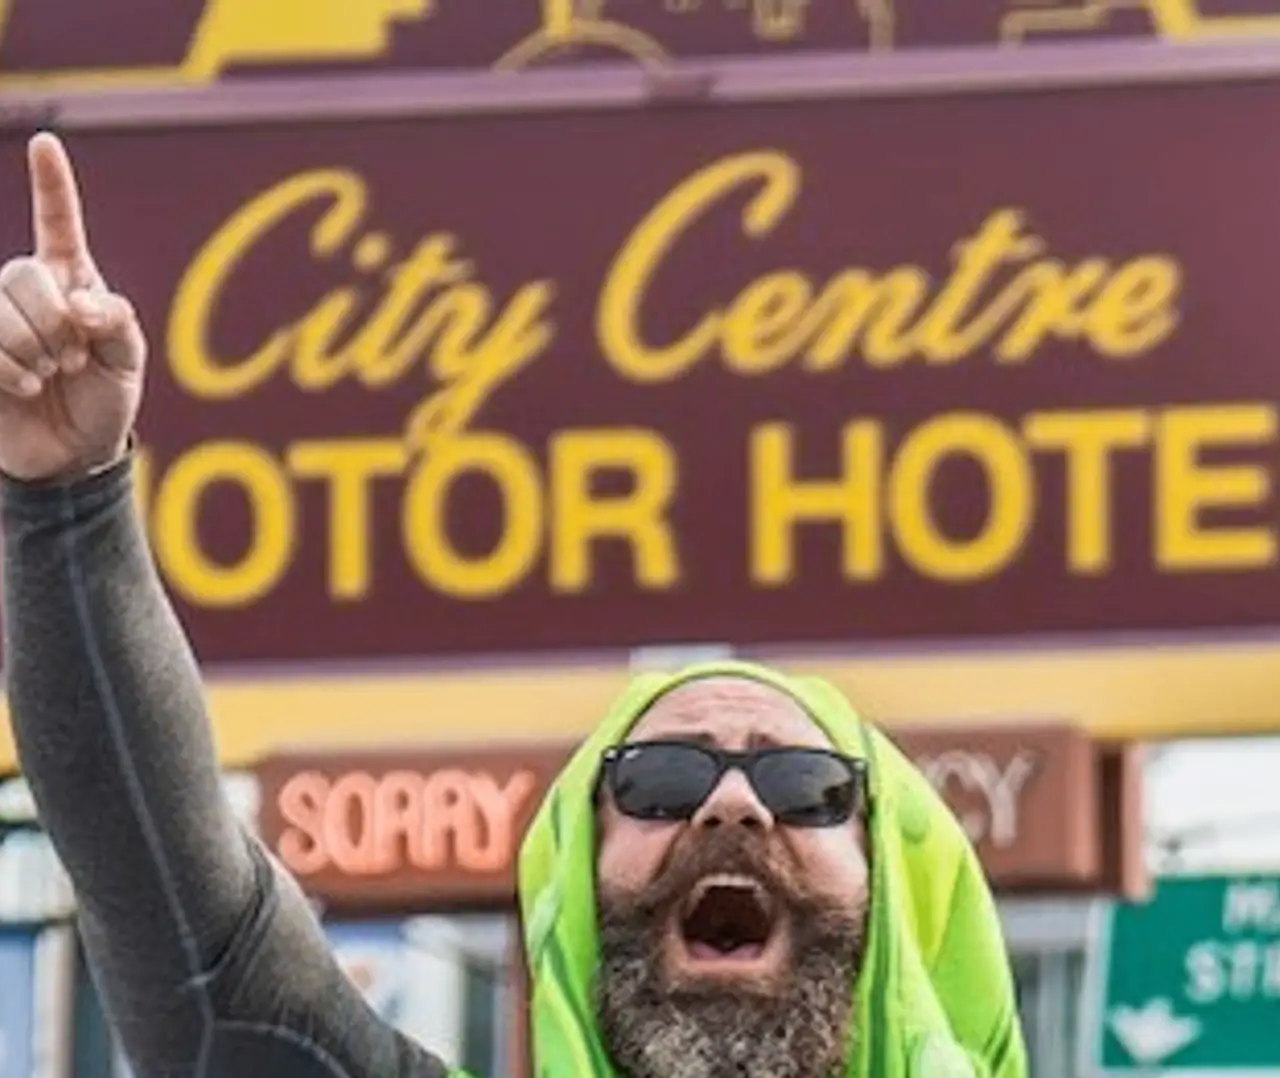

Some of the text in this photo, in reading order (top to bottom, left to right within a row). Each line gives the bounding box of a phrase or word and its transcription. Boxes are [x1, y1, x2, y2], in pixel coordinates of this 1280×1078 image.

[166, 150, 1180, 436] City Centre
[136, 426, 678, 604] OTOR
[278, 768, 533, 874] SORRY
